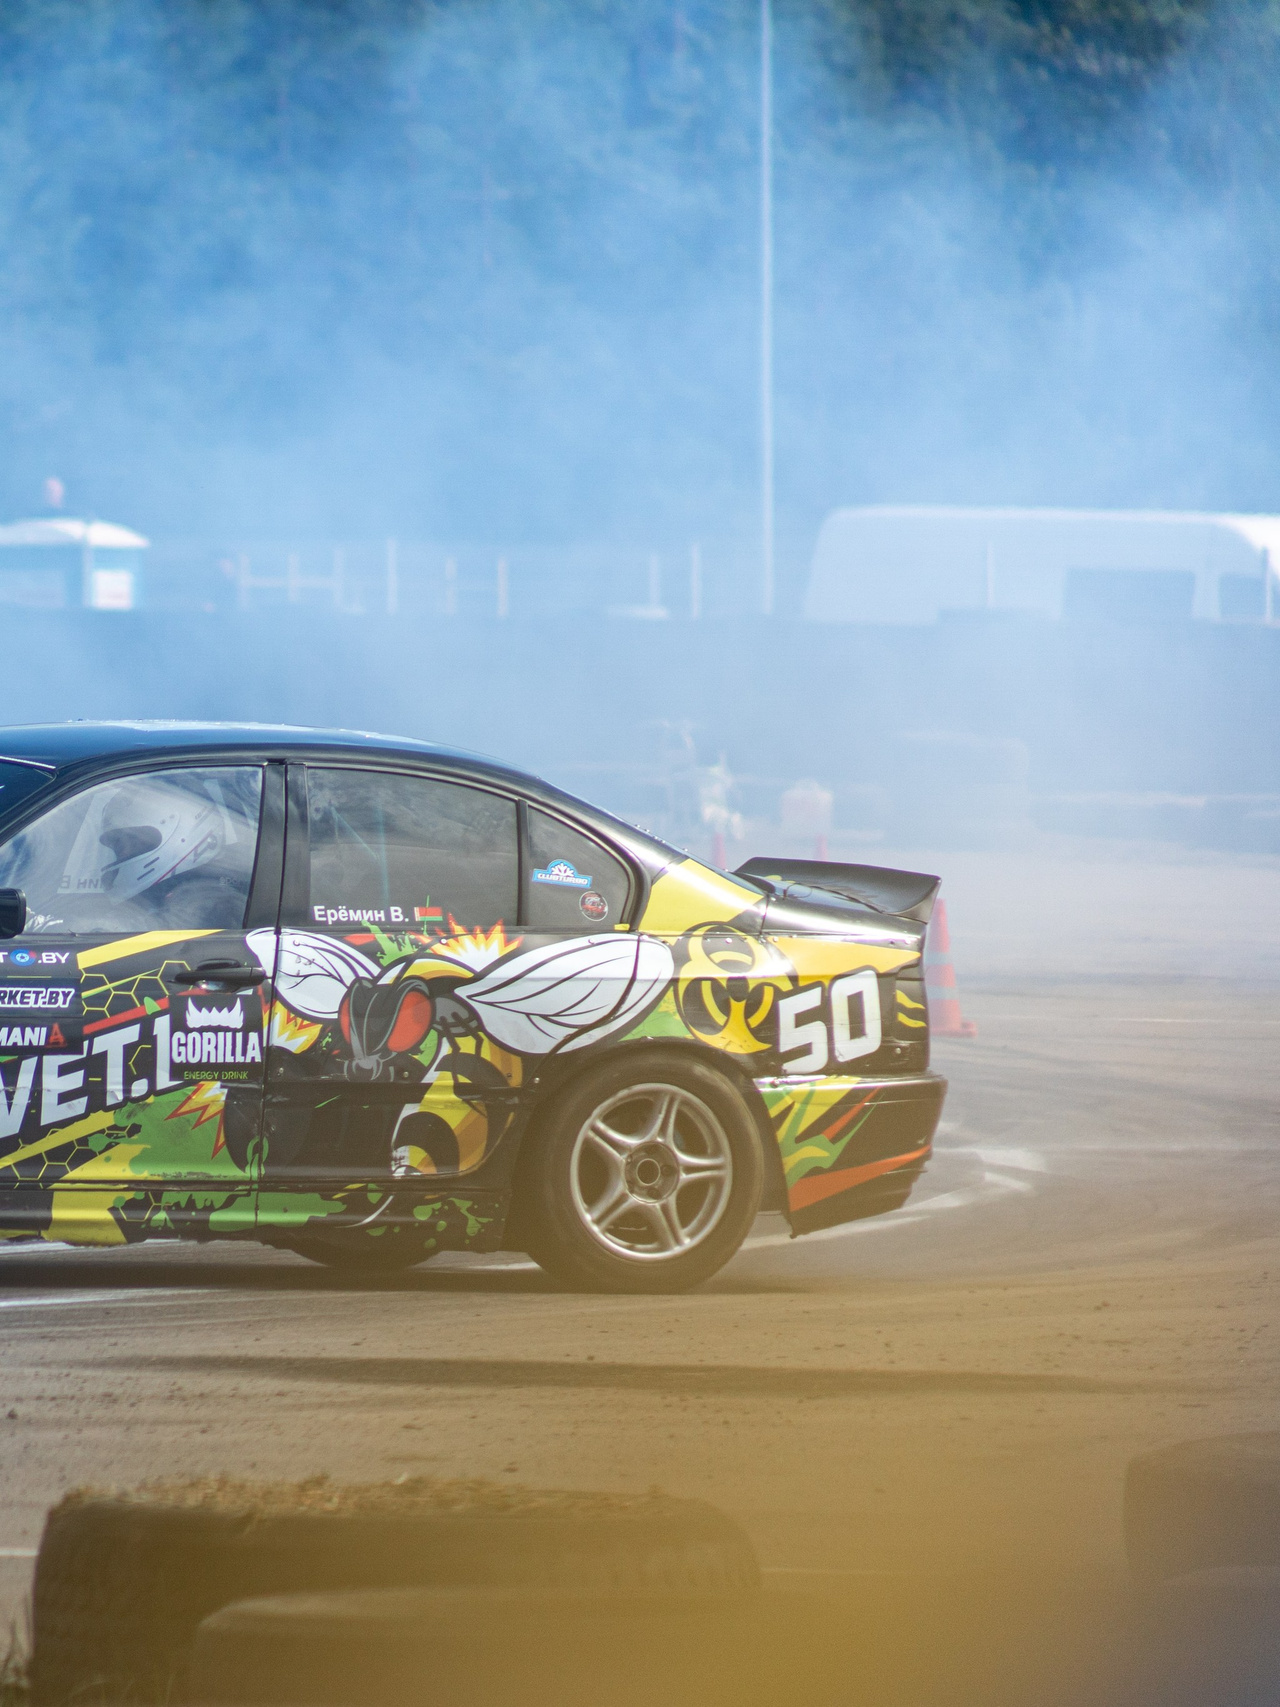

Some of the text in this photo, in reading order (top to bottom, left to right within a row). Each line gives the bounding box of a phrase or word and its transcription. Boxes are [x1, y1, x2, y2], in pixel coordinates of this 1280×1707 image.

[313, 905, 385, 925] Ерёмин
[778, 969, 882, 1074] 50
[171, 1031, 262, 1064] GORILLA
[183, 1070, 249, 1080] ENERGY DRINK
